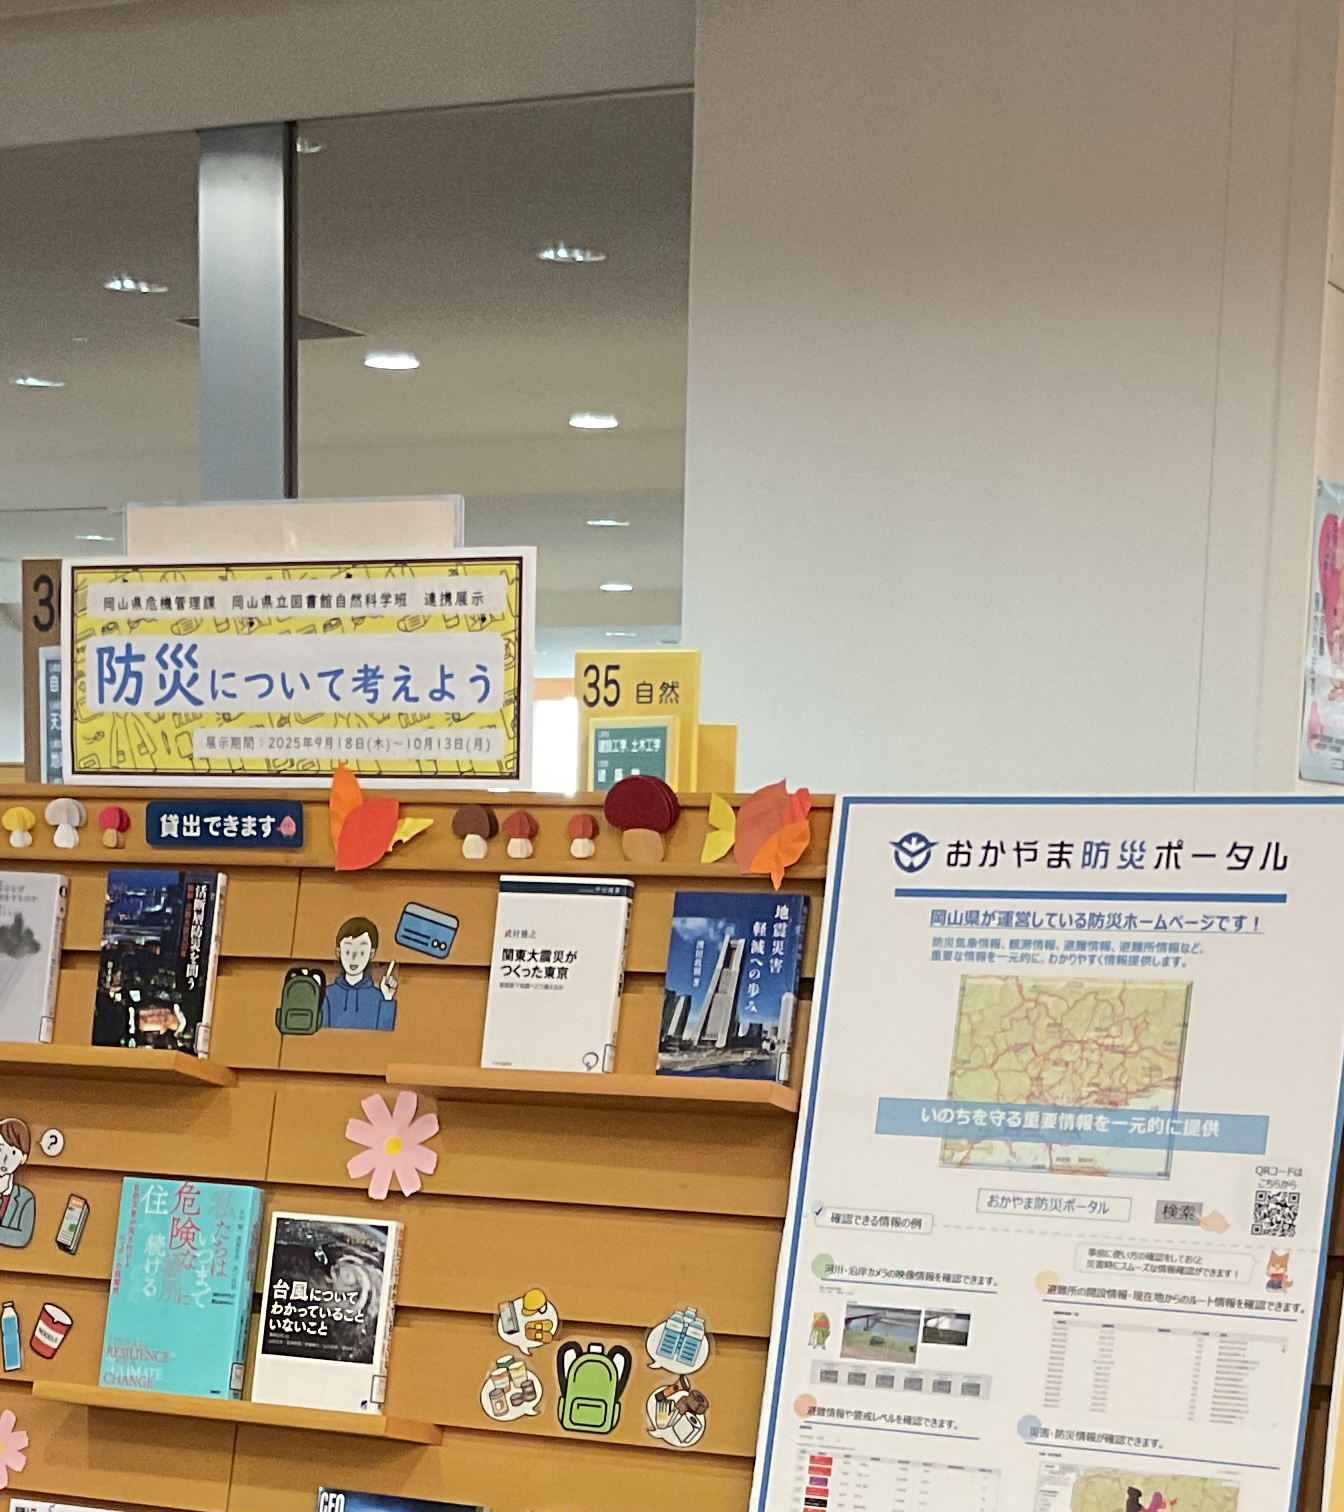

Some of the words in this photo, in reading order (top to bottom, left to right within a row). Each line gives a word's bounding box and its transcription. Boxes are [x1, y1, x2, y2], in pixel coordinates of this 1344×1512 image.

[95, 641, 493, 706] 防災について考えよう
[582, 663, 622, 709] 35
[635, 679, 681, 706] 自然
[160, 813, 277, 839] 貸出できます
[945, 837, 1289, 874] おかやま防災ポータル
[768, 903, 791, 975] 地震災害
[500, 947, 579, 965] 関東大震災が
[743, 920, 768, 1014] 軽減への歩み
[500, 964, 569, 981] つくった東京
[921, 1105, 1220, 1138] いのちを守る重要情報を一元的に提供
[987, 1193, 1110, 1216] おかやま防災ポータル
[1161, 1203, 1196, 1221] 検索
[830, 1211, 923, 1230] 確認できる情報の例
[272, 1278, 359, 1306] 台風について
[270, 1301, 366, 1324] わかっていること
[269, 1318, 329, 1338] いないこと
[106, 1345, 171, 1364] RESILIENCE
[102, 1371, 154, 1389] CHANGE
